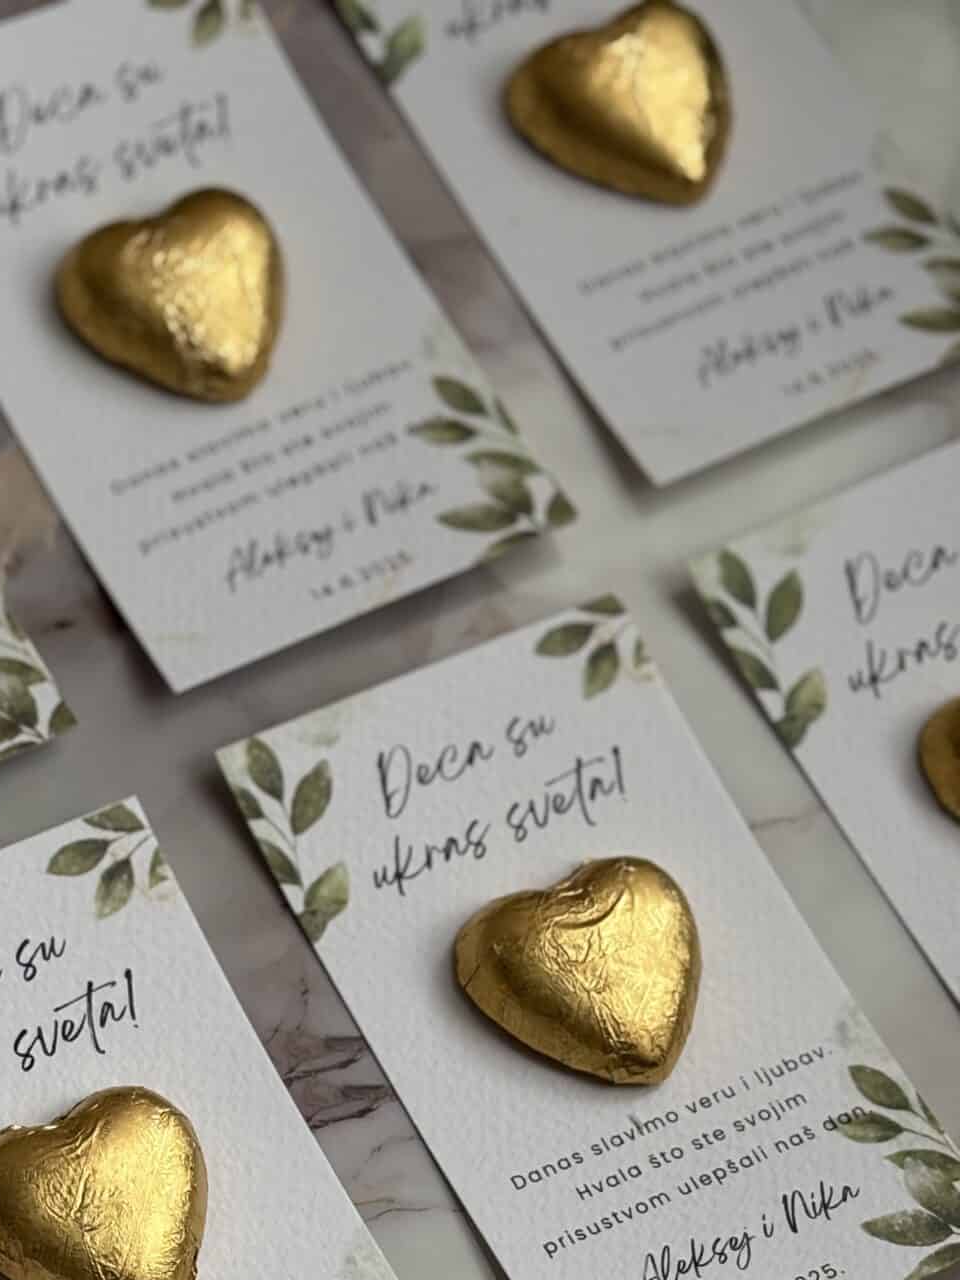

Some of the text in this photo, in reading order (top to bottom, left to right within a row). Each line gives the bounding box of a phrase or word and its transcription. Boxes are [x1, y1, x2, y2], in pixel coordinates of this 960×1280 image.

[376, 714, 555, 820] Deca su
[373, 744, 626, 897] ukras sveta!
[15, 936, 66, 982] su
[13, 967, 138, 1072] sveta!
[510, 1151, 584, 1190] Danas
[590, 1111, 679, 1156] slavimo
[684, 1085, 736, 1113] veru
[740, 1075, 751, 1092] i
[575, 1094, 807, 1201] Hvala što ste svojim
[542, 1192, 671, 1260] prisustvom
[677, 1146, 768, 1195] ulepšali
[774, 1126, 816, 1154] naš
[761, 1213, 774, 1238] i
[781, 1180, 860, 1233] Nika
